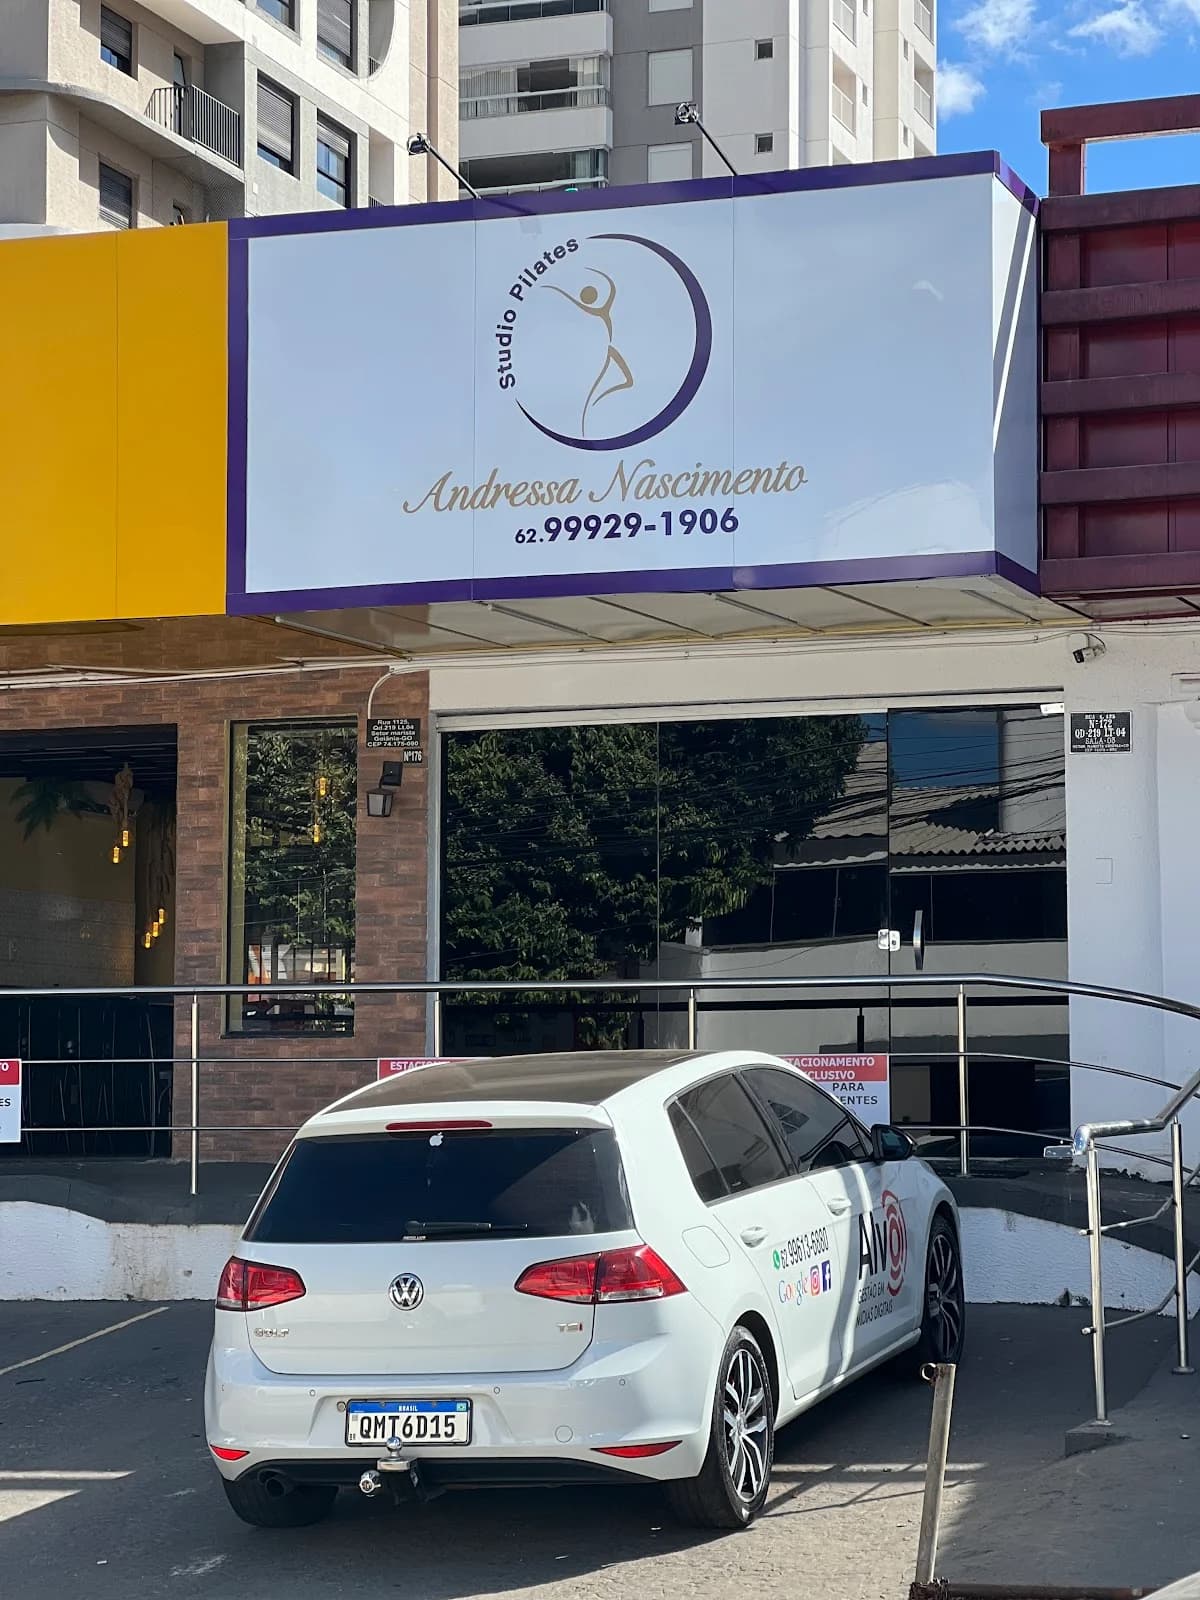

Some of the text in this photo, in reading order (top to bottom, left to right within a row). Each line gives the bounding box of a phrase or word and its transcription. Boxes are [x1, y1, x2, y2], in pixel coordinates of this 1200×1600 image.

[496, 238, 579, 389] Studio Pilates
[403, 458, 809, 513] Andressa Nascimento
[804, 1070, 856, 1080] CLUSIVO
[832, 1082, 865, 1092] PARA
[838, 1095, 878, 1105] ENTES
[780, 1249, 789, 1269] 62
[398, 1404, 418, 1412] BRASIL
[360, 1414, 456, 1439] QMT6D15
